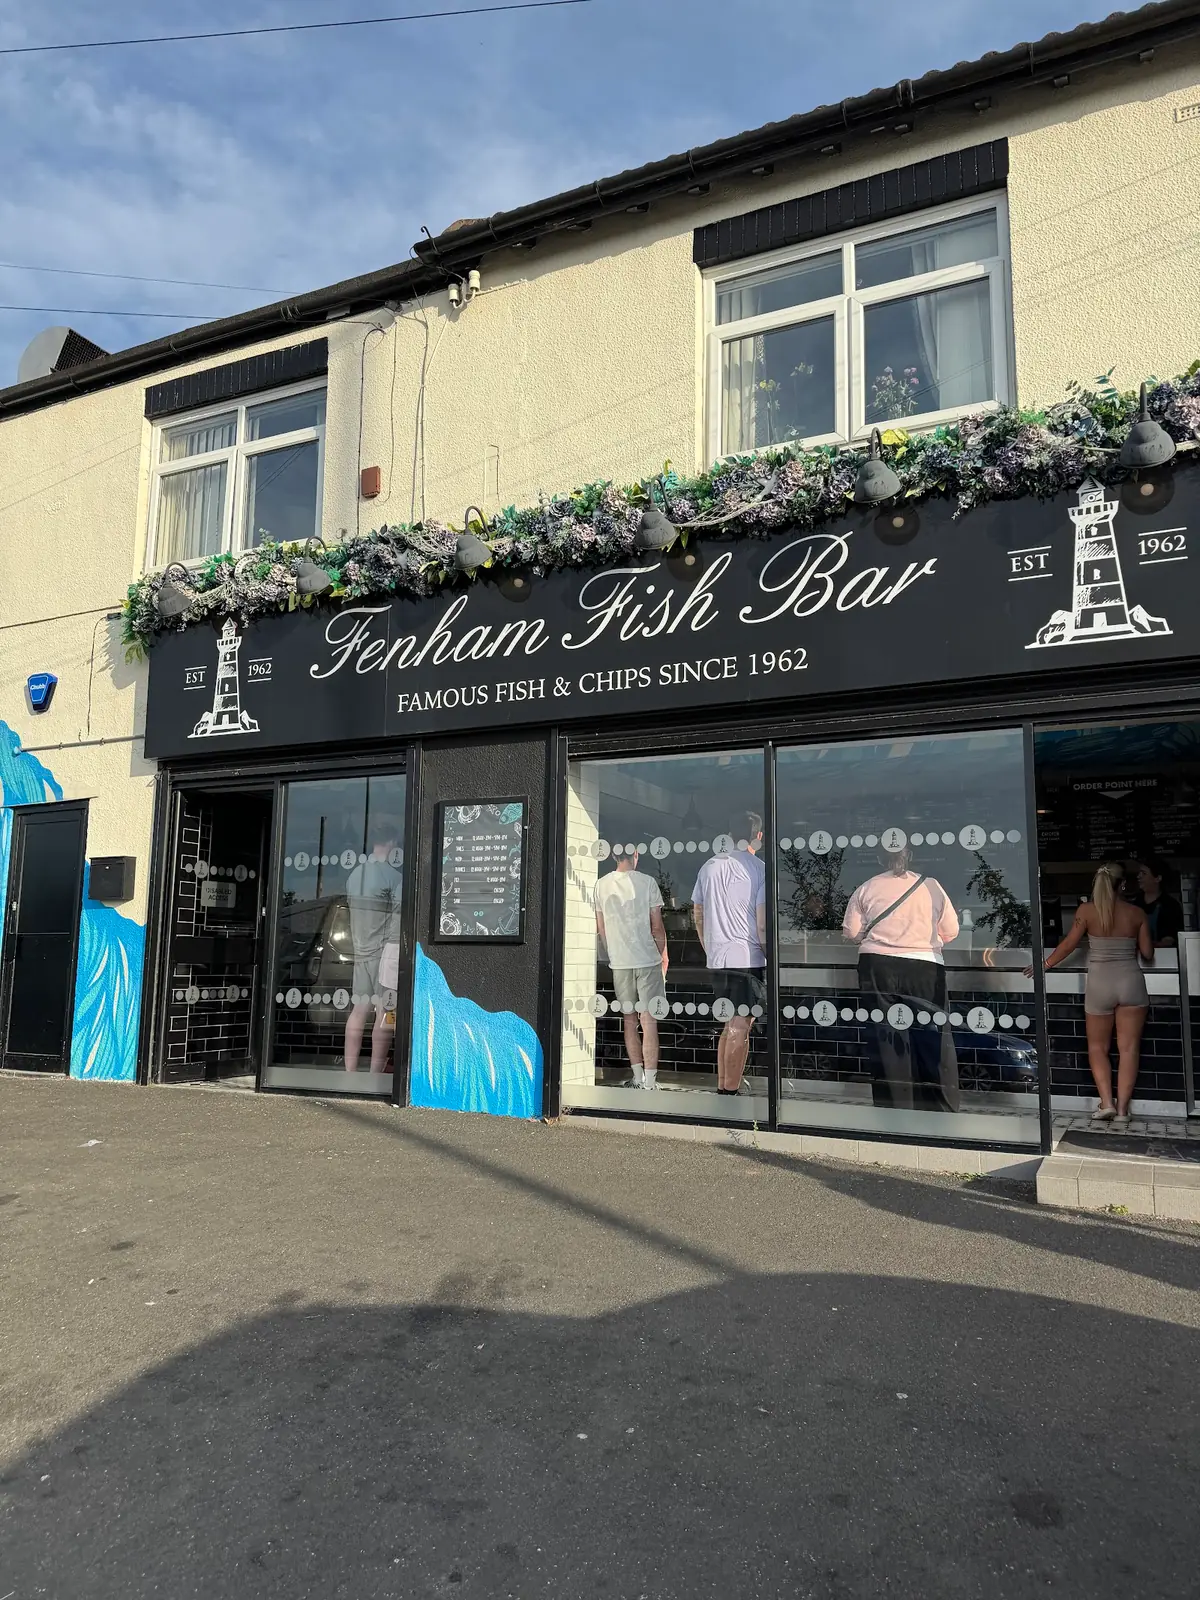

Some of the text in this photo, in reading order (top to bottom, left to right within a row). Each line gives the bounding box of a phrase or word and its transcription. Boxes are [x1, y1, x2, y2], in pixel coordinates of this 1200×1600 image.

[1138, 535, 1187, 556] 1962
[1011, 553, 1050, 573] EST
[310, 531, 938, 679] Fenham Fish Bar
[186, 671, 206, 684] EST
[248, 663, 272, 677] 1962
[398, 648, 809, 714] FAMOUS FISH & CHIPS SINCE 1962
[1073, 782, 1102, 791] ORDER
[1135, 779, 1158, 787] HERE
